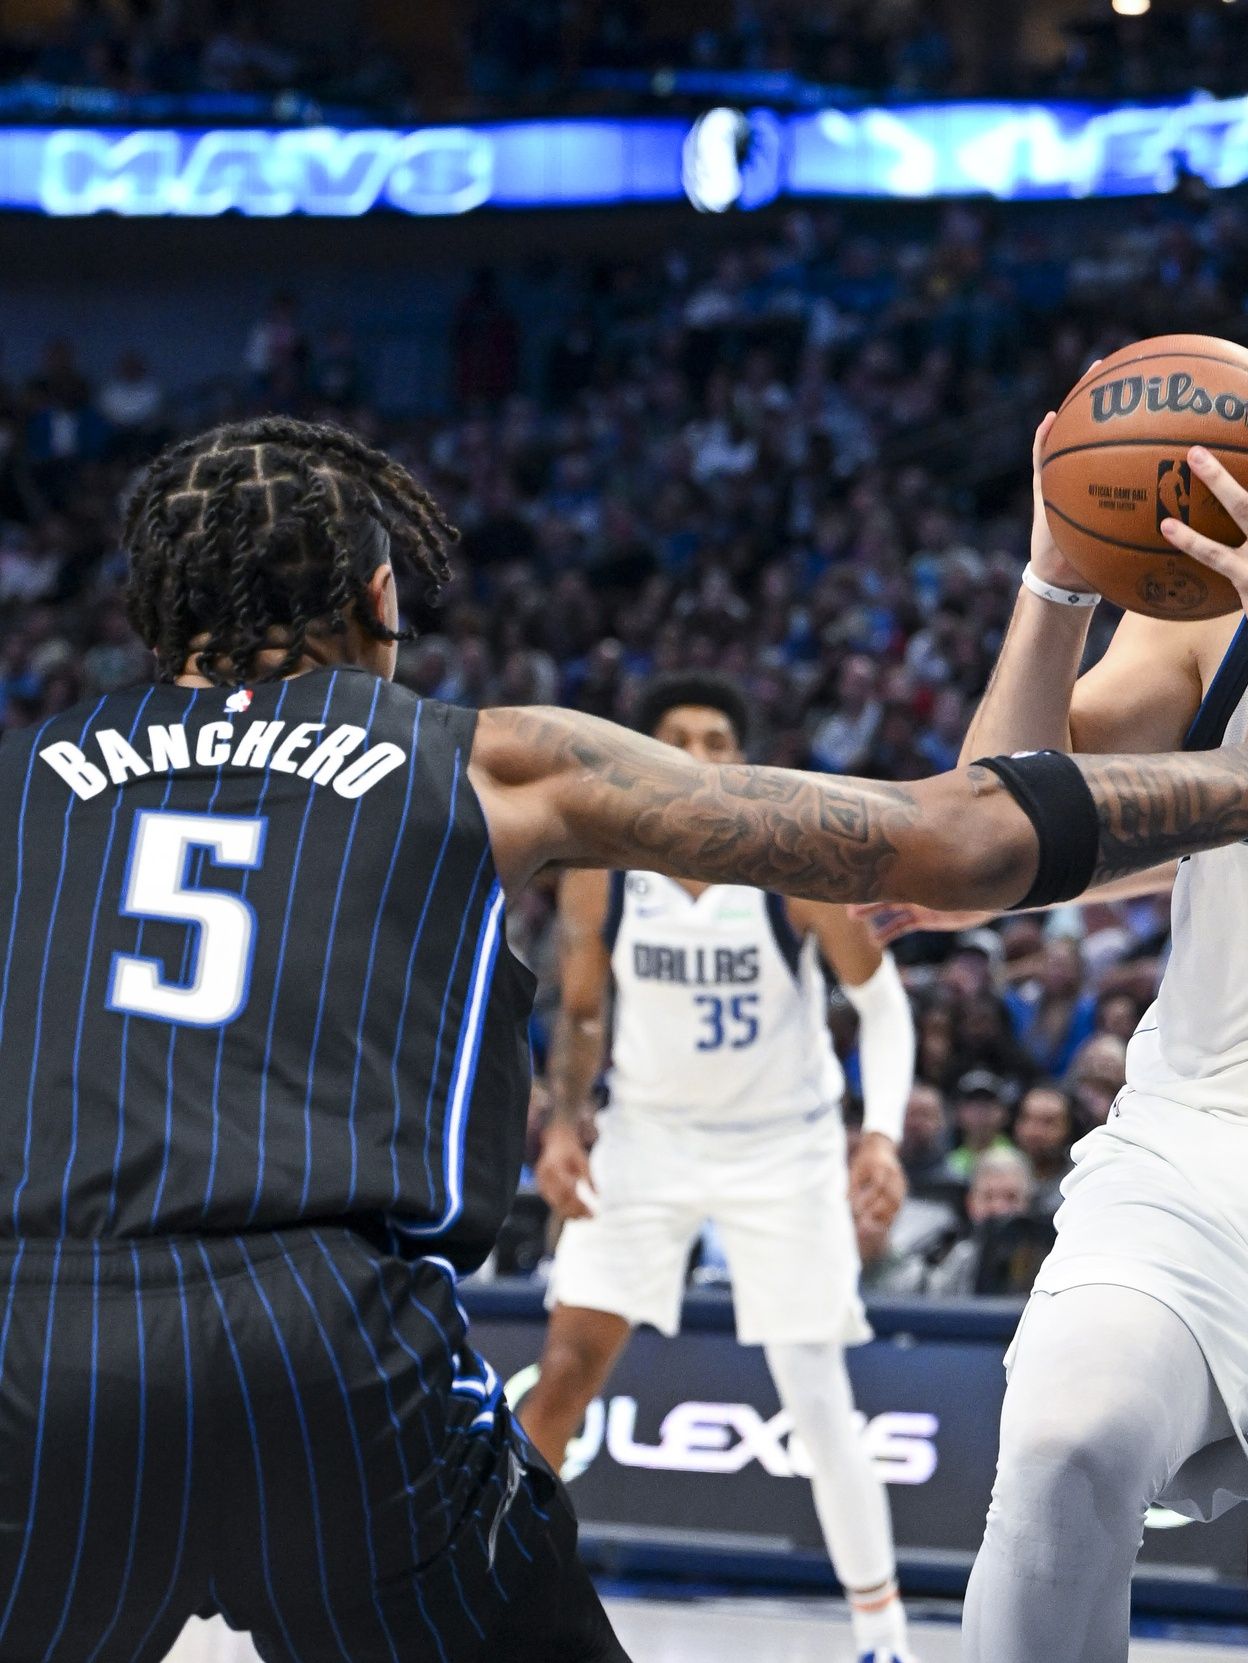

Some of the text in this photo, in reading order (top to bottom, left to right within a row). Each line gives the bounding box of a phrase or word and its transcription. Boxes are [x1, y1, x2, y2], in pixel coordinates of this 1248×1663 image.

[38, 719, 407, 802] BANCHERO
[104, 807, 269, 1030] 5
[631, 942, 760, 986] DALLAS
[692, 992, 760, 1052] 35
[606, 1394, 940, 1485] LEXS
